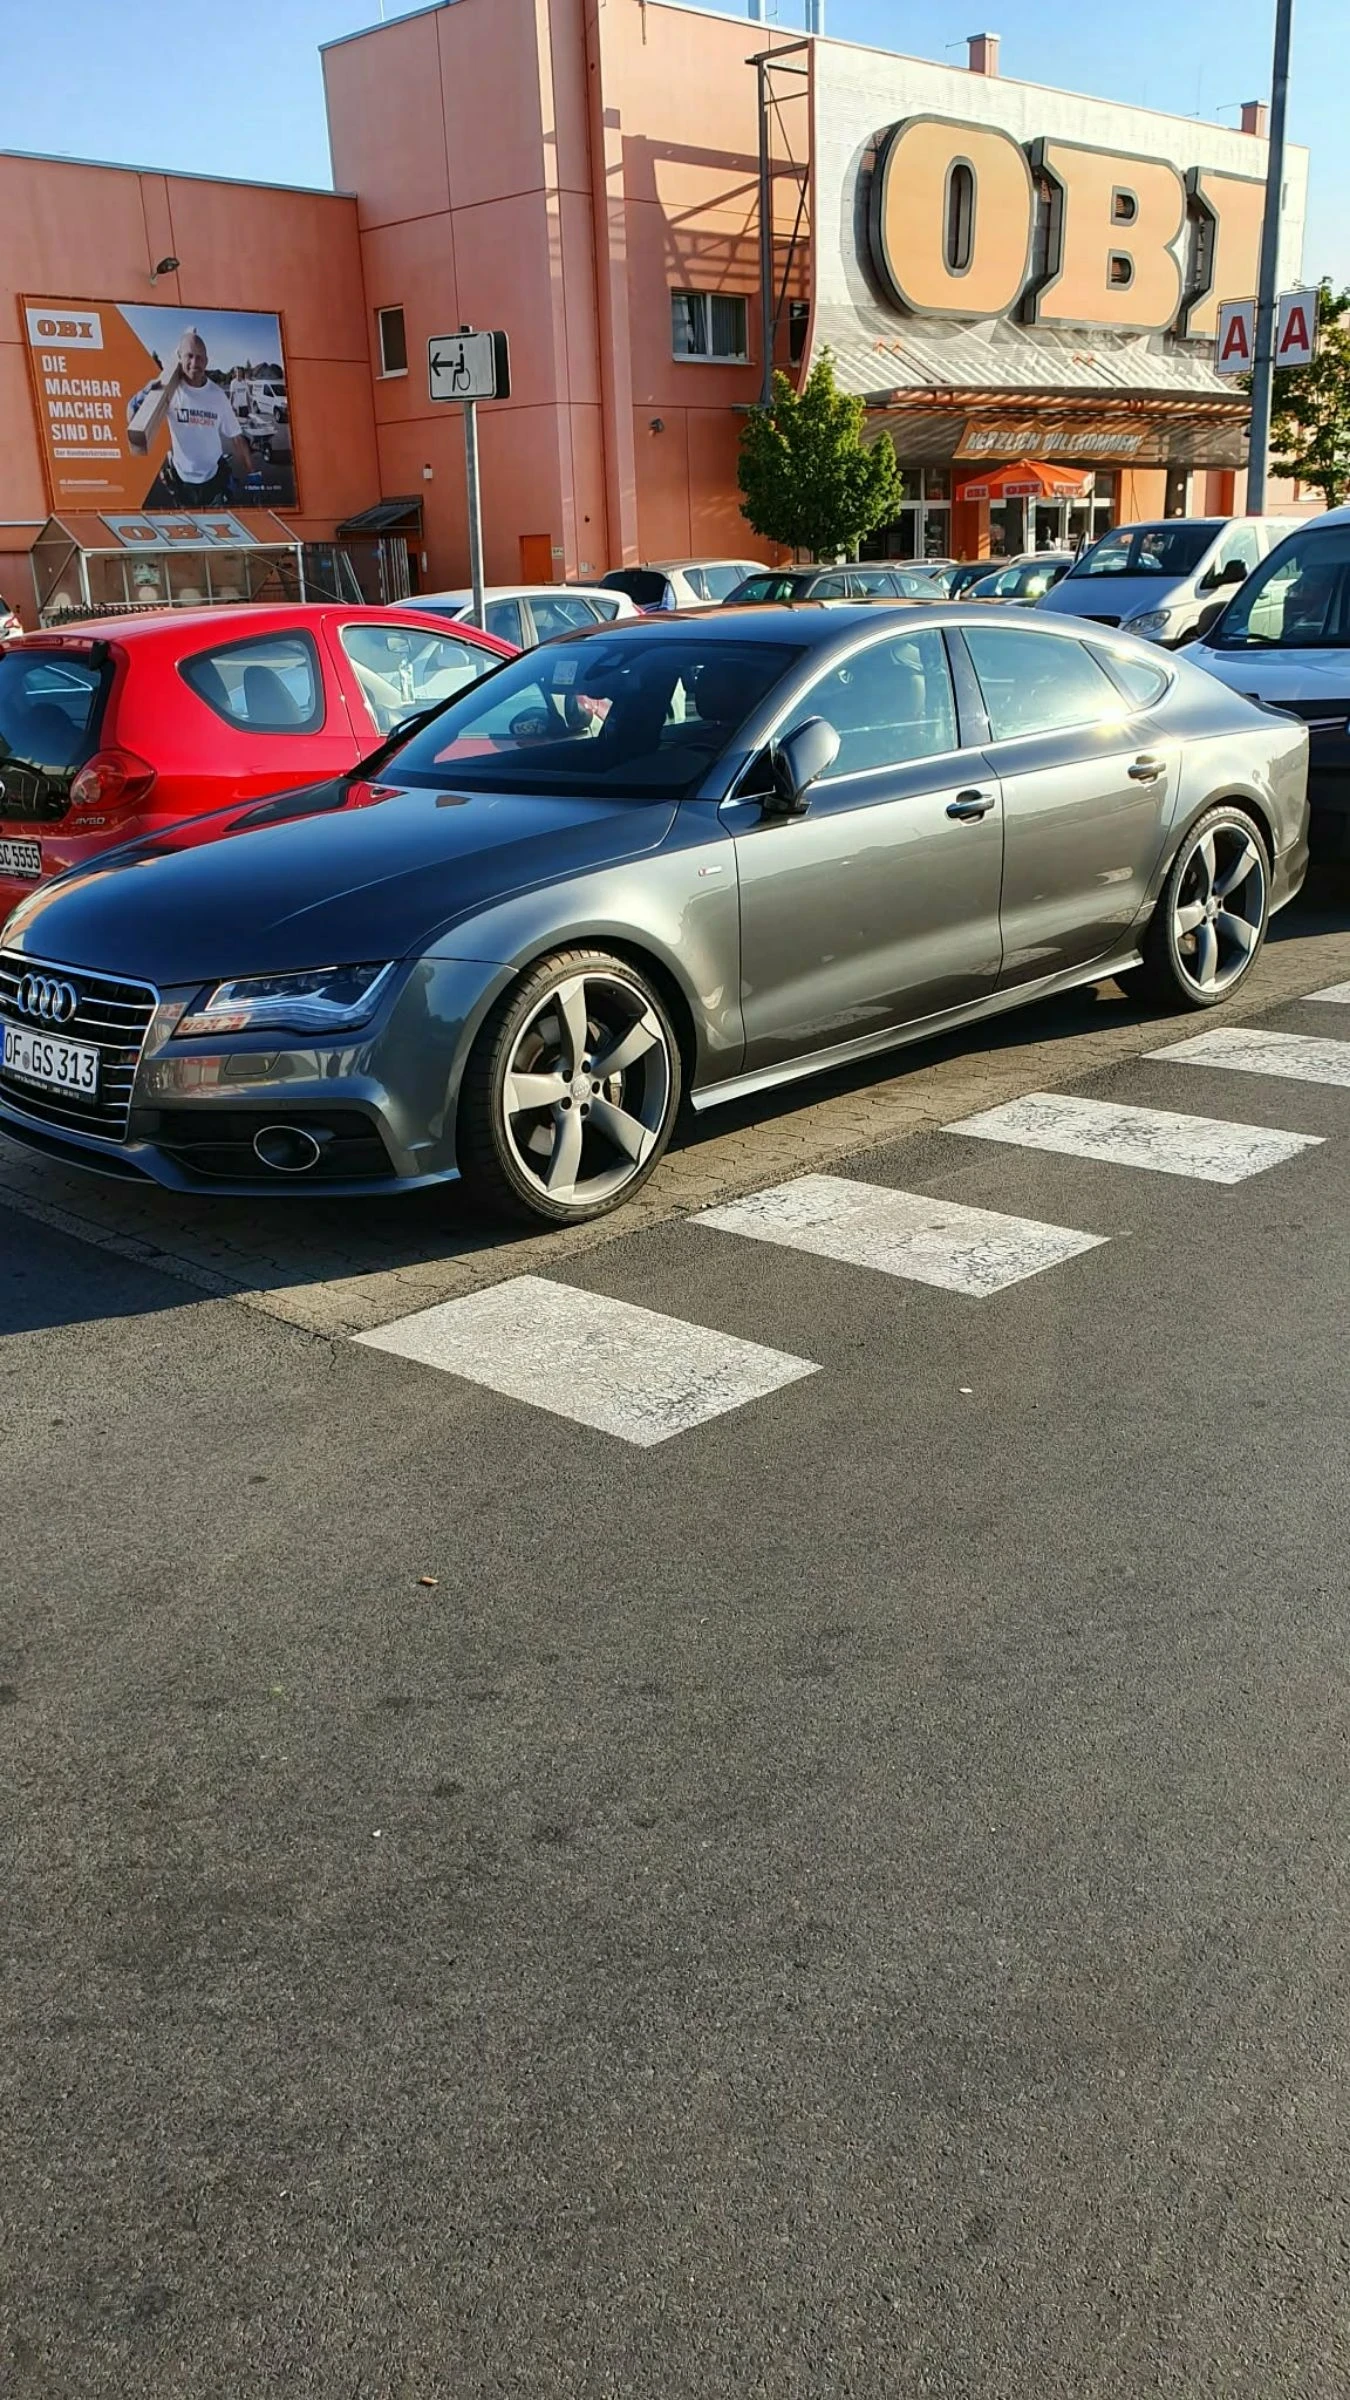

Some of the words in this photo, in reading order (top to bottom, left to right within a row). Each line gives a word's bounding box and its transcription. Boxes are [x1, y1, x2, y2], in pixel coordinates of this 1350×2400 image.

[874, 113, 1270, 341] OBI
[37, 319, 93, 338] OBI
[1221, 315, 1249, 361] A
[1279, 306, 1310, 354] A
[41, 355, 67, 372] DIE
[45, 378, 121, 398] MACHBAR
[48, 401, 113, 419] MACHER
[51, 424, 88, 441] SIND
[92, 425, 118, 441] DA.
[966, 431, 1041, 450] HERZLICH
[1005, 483, 1041, 495] OBI
[118, 524, 240, 541] OBI
[12, 845, 40, 869] 5555
[5, 1032, 22, 1065] OF
[32, 1040, 54, 1077] GS
[57, 1048, 95, 1088] 313
